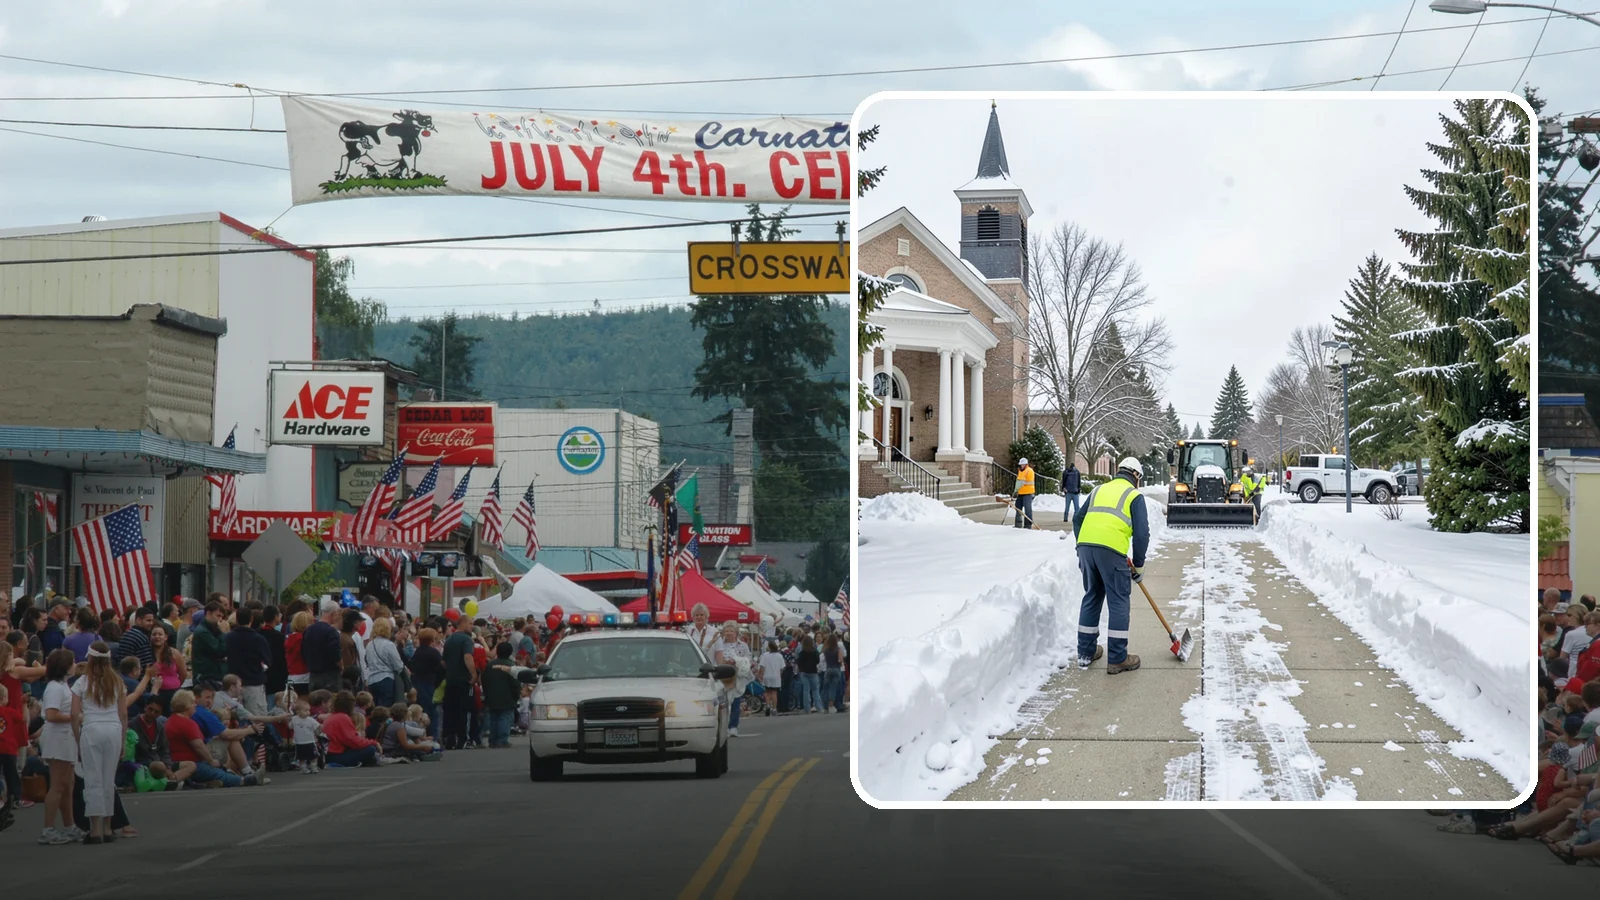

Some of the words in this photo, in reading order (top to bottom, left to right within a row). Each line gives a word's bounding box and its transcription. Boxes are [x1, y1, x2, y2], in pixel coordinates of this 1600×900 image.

[481, 140, 605, 193] JULY
[632, 150, 746, 199] 4th.
[697, 254, 850, 279] CROSSWA
[283, 380, 373, 420] ACE
[406, 409, 452, 421] CEDAR
[461, 409, 485, 421] LOG
[283, 421, 371, 436] Hardware
[353, 467, 386, 480] Simpl
[95, 485, 124, 494] Vincent
[126, 486, 135, 494] de
[137, 486, 155, 495] Paul
[81, 503, 153, 521] THRT
[699, 535, 730, 543] GLASS
